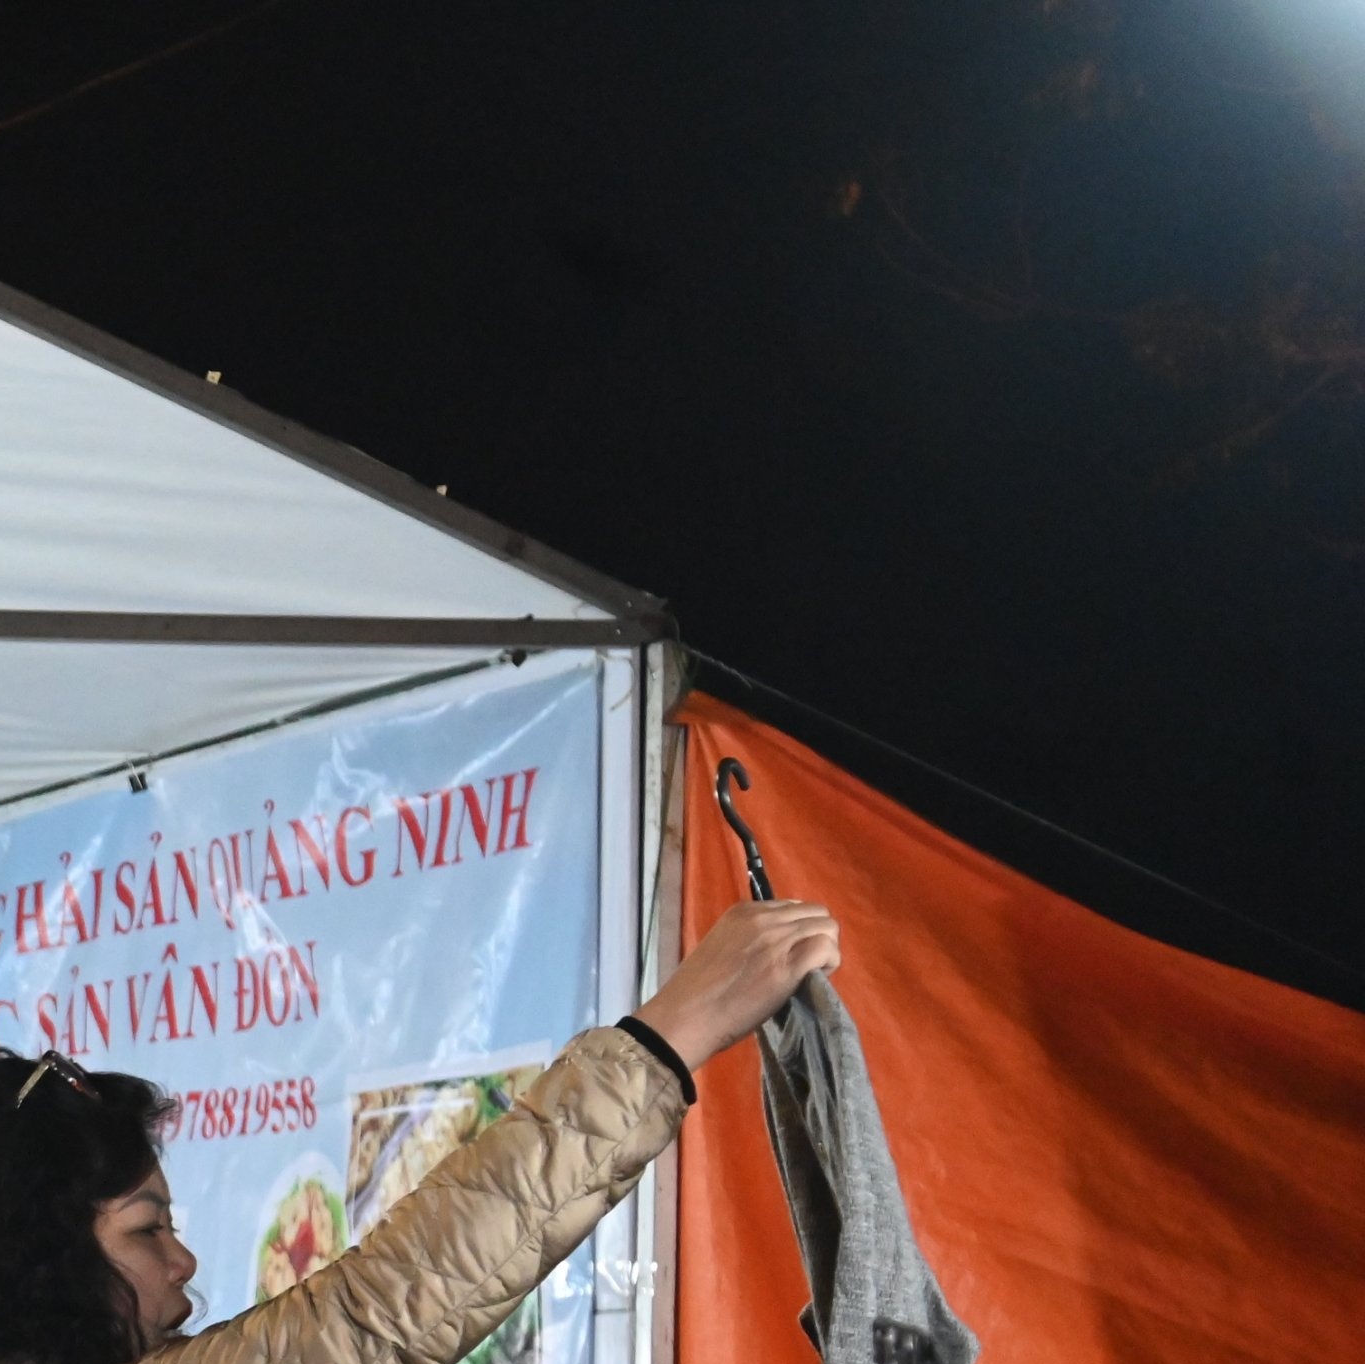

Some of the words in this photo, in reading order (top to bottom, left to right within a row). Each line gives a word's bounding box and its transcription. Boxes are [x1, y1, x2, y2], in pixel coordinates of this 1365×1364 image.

[14, 851, 104, 954] HẢI
[113, 831, 199, 936] SẢN
[207, 798, 378, 931] QUẢNG
[392, 766, 539, 878] NINH
[127, 942, 220, 1044] VÂN
